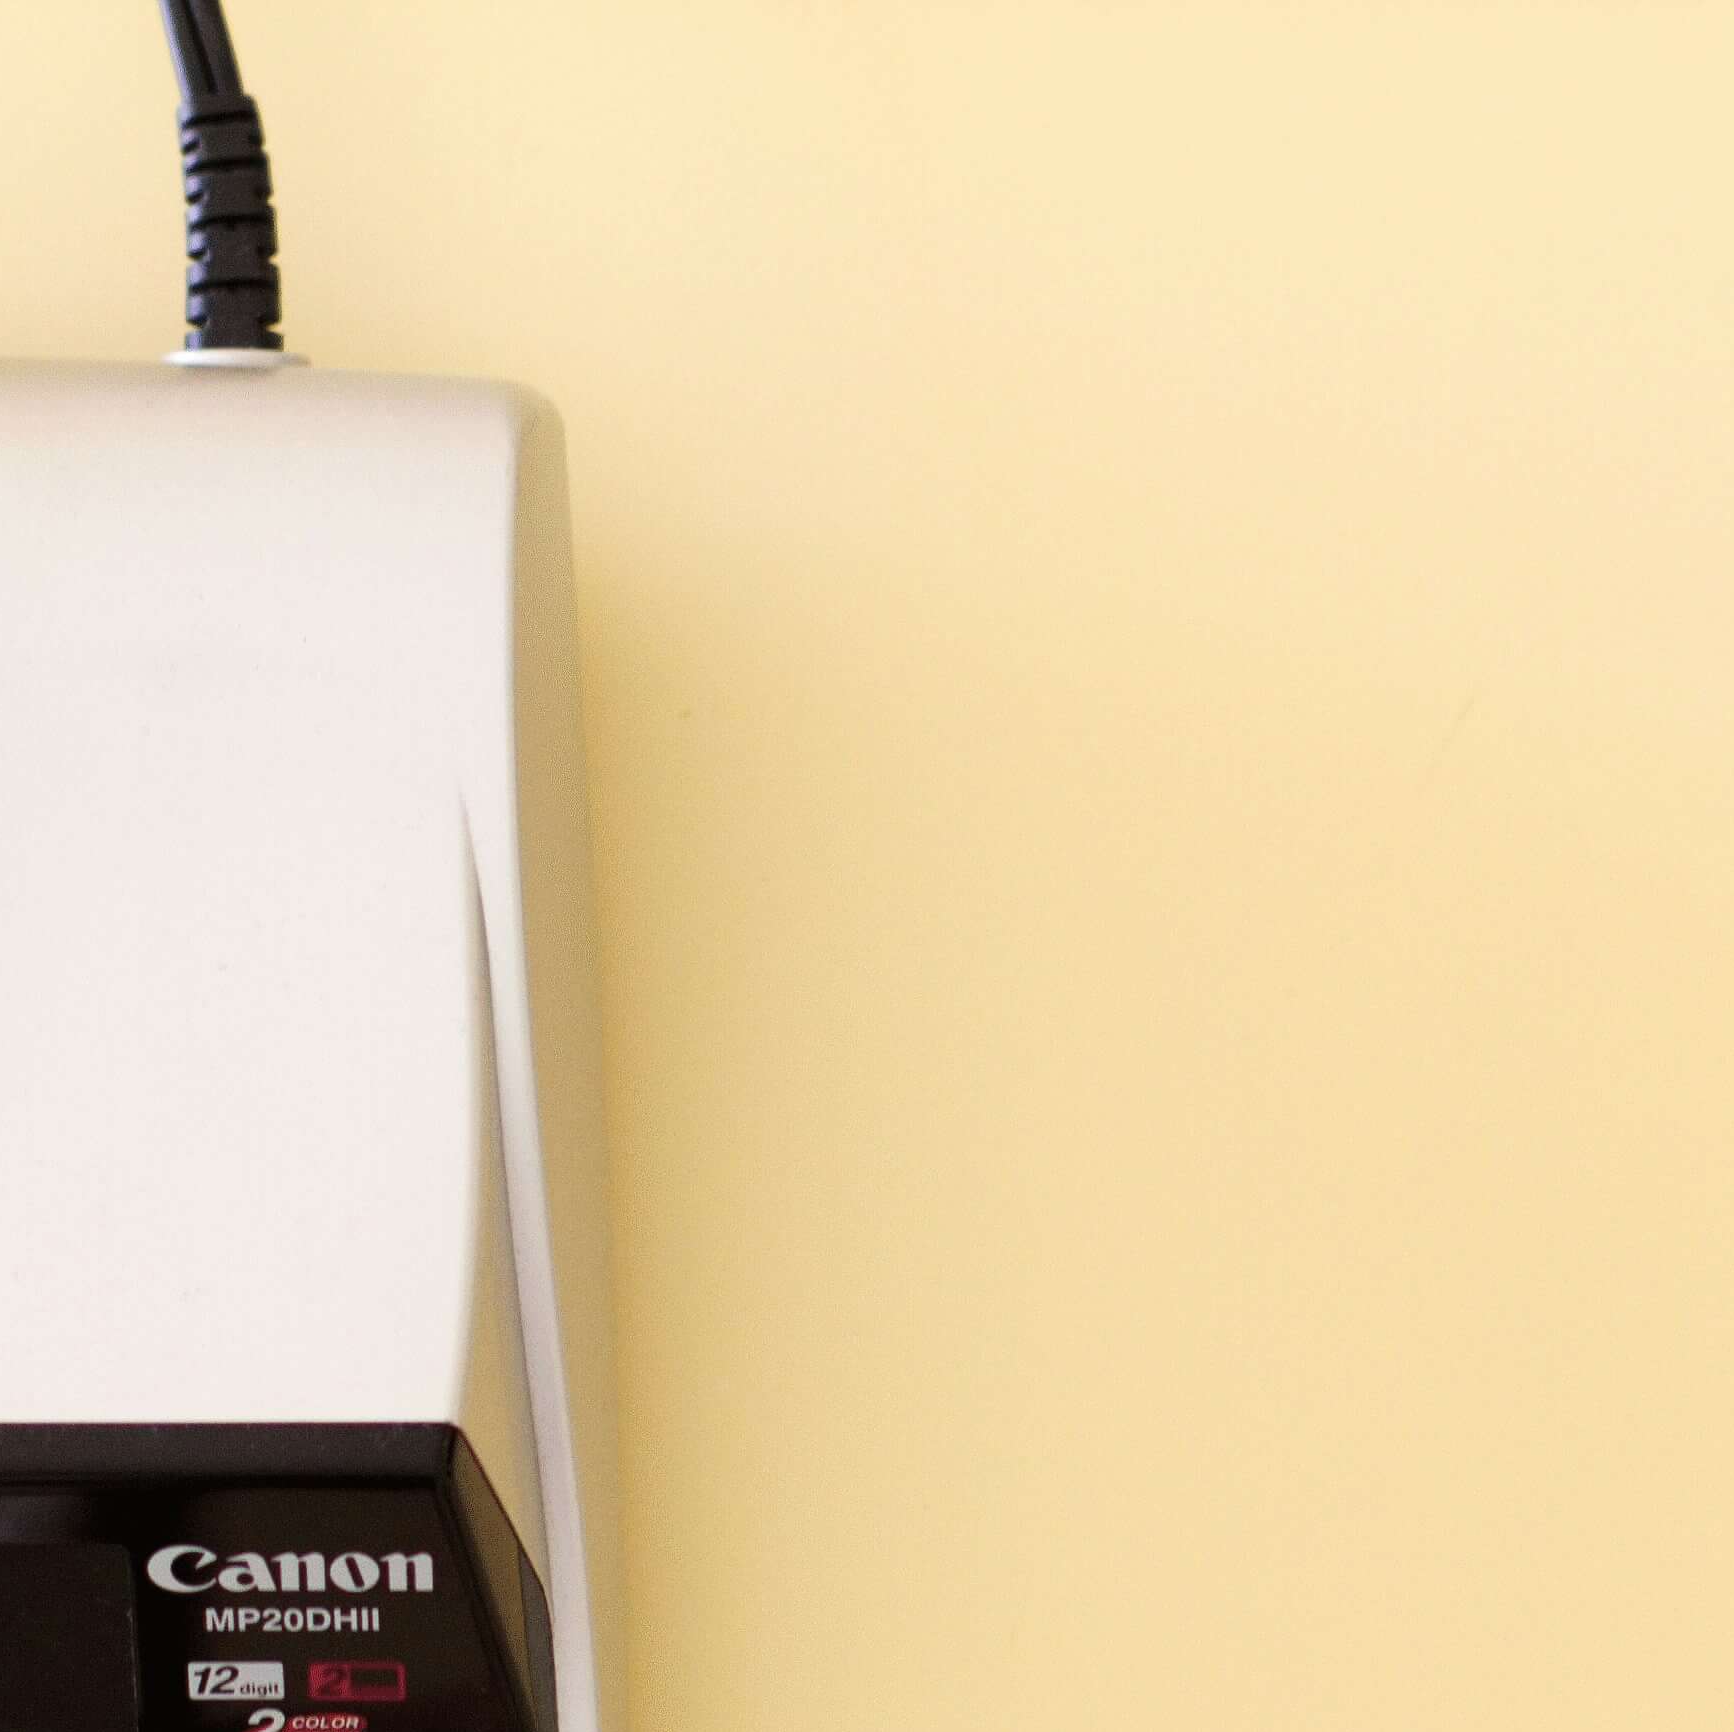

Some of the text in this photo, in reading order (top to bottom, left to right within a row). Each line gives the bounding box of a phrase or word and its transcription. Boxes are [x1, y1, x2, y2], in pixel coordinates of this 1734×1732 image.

[147, 1545, 434, 1593] Canon
[205, 1607, 380, 1632] MP20DHII
[193, 1664, 279, 1698] 12 digit
[291, 1716, 360, 1730] COLOR
